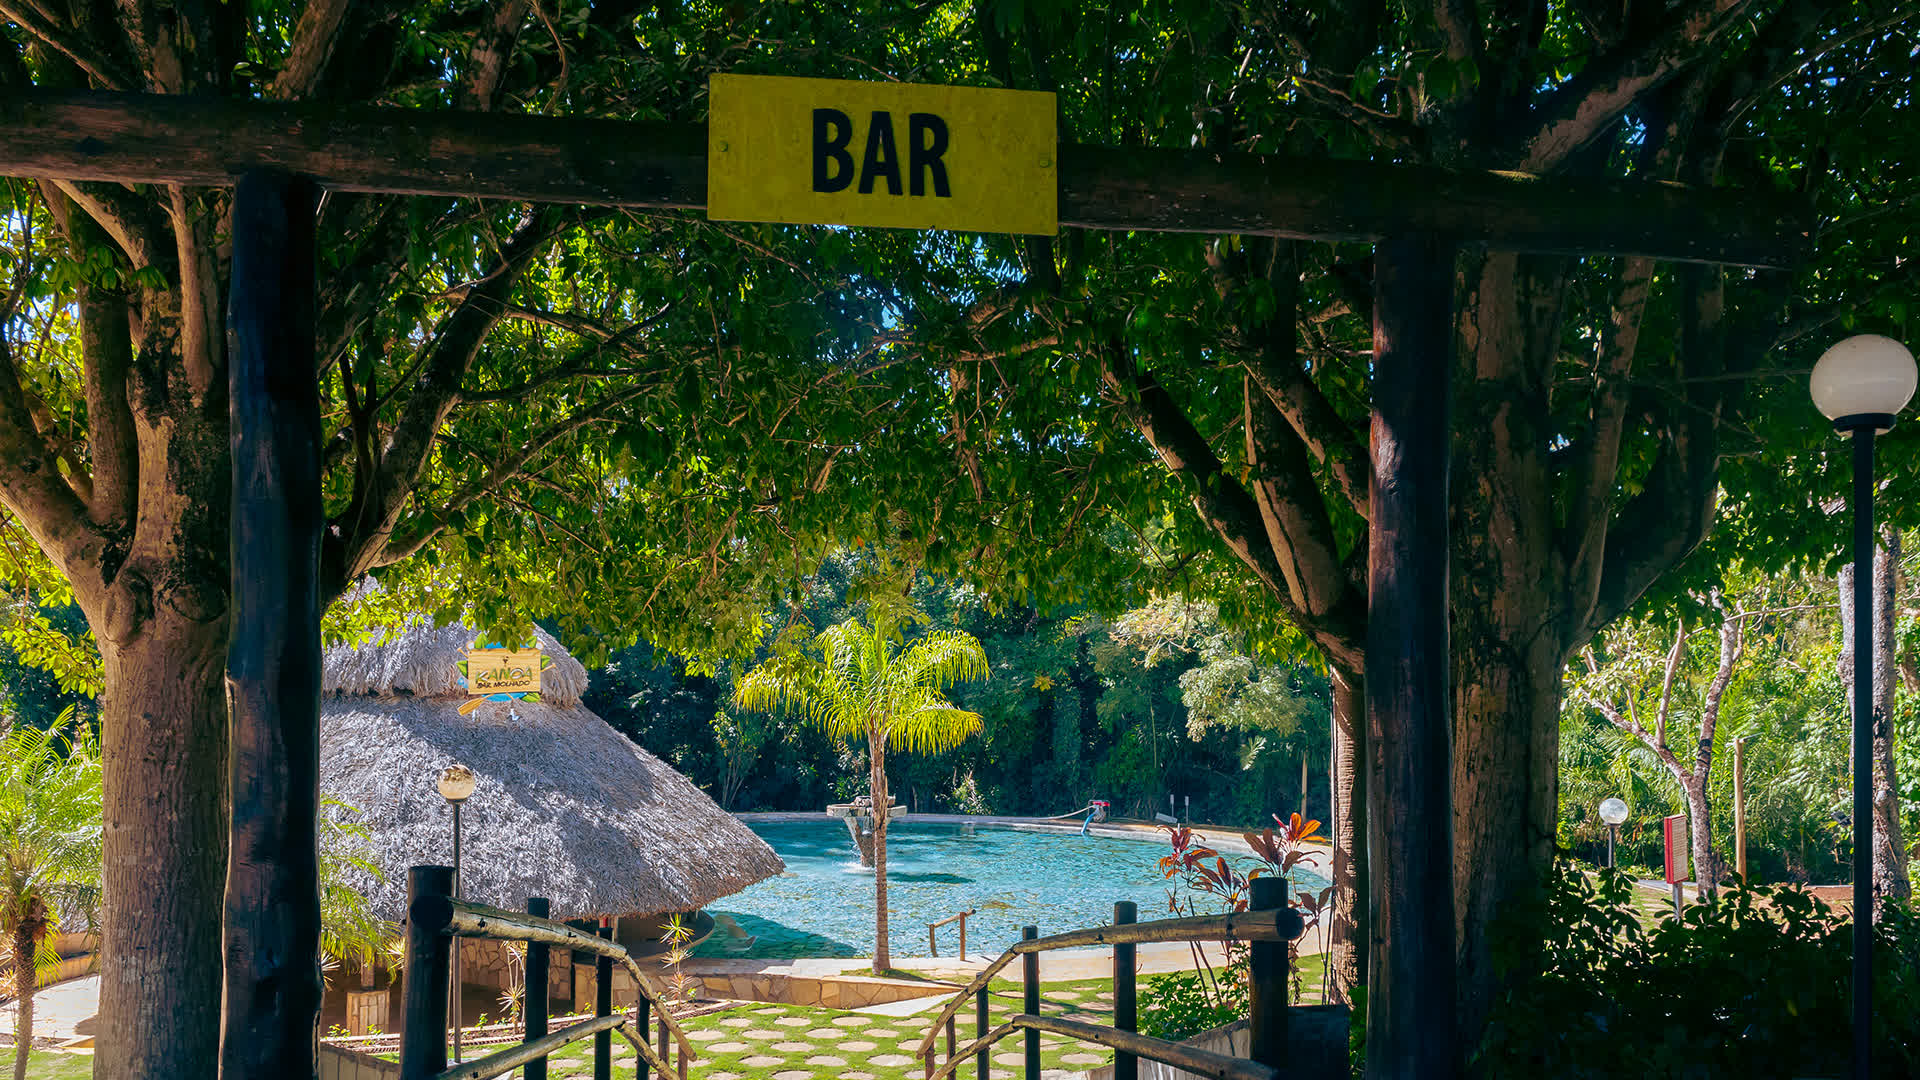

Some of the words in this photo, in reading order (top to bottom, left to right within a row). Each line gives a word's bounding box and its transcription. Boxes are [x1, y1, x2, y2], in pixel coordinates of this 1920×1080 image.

[813, 108, 952, 198] BAR
[476, 666, 533, 684] KANOA
[493, 680, 531, 688] MOLHADO
